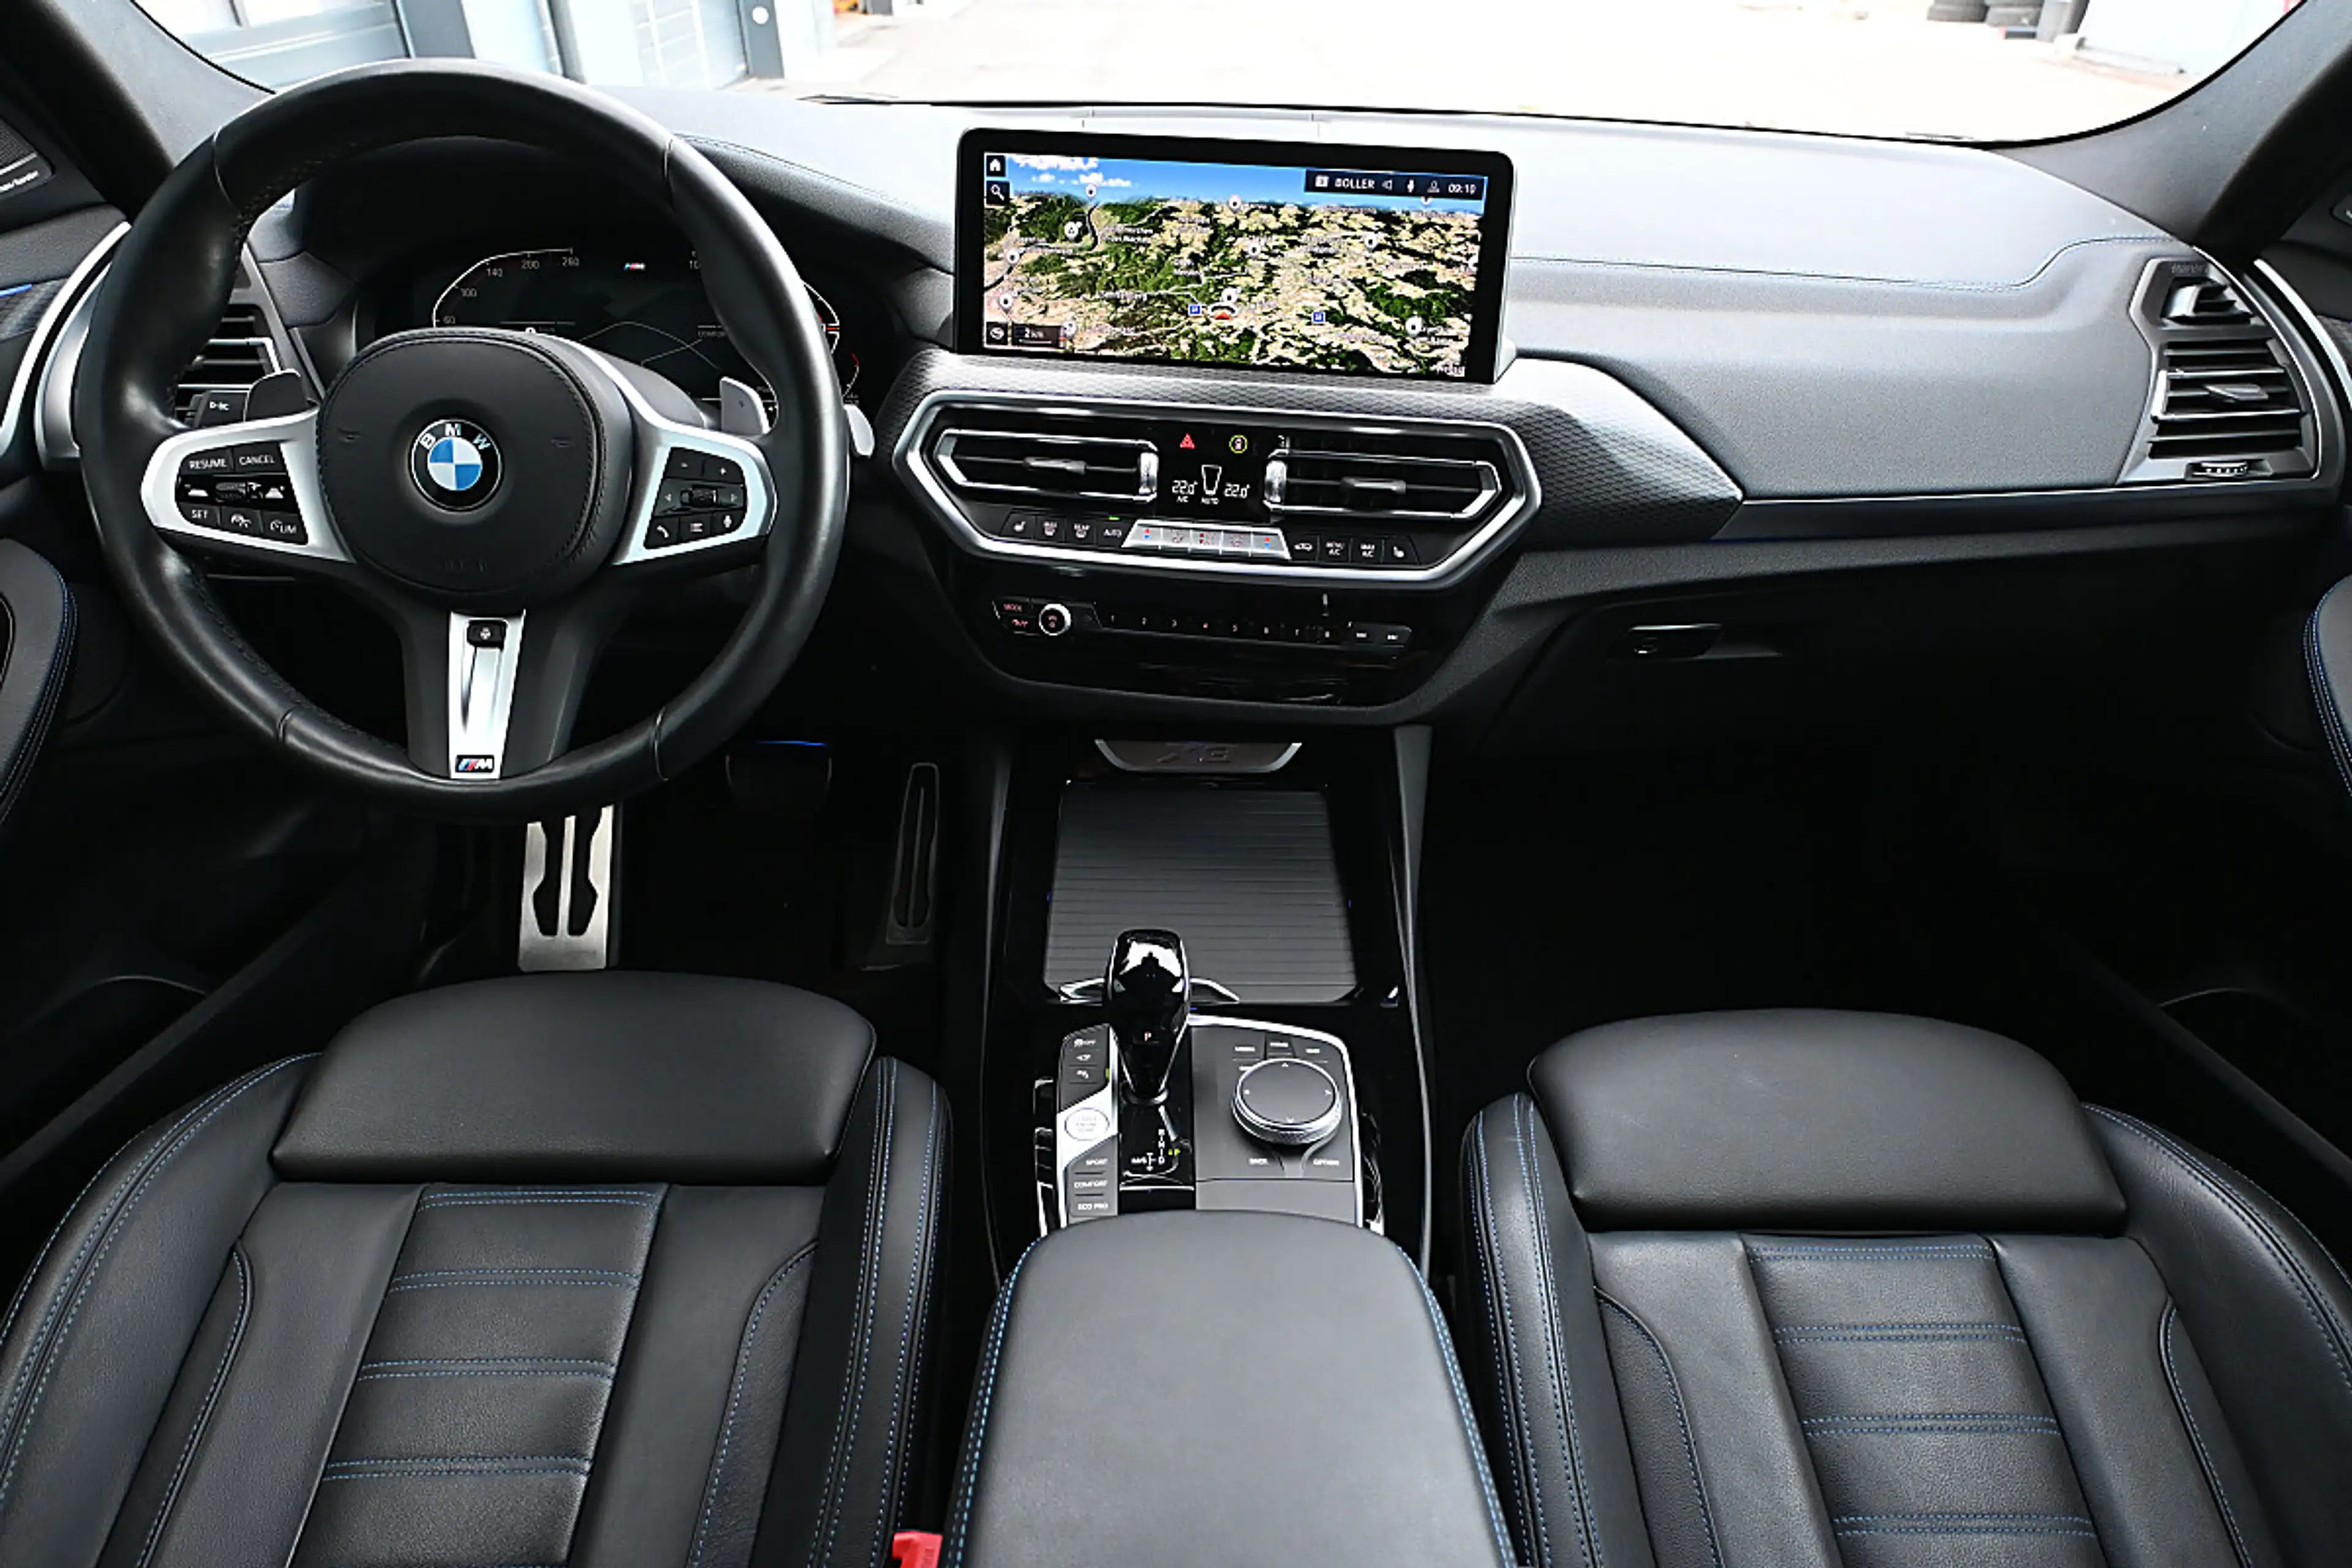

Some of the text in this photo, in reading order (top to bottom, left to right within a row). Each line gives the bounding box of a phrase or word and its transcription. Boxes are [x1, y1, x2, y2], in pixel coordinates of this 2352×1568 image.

[420, 423, 490, 450] BMW
[189, 458, 227, 470] RESUME
[239, 455, 275, 466] CANCEL
[192, 510, 208, 519] SET
